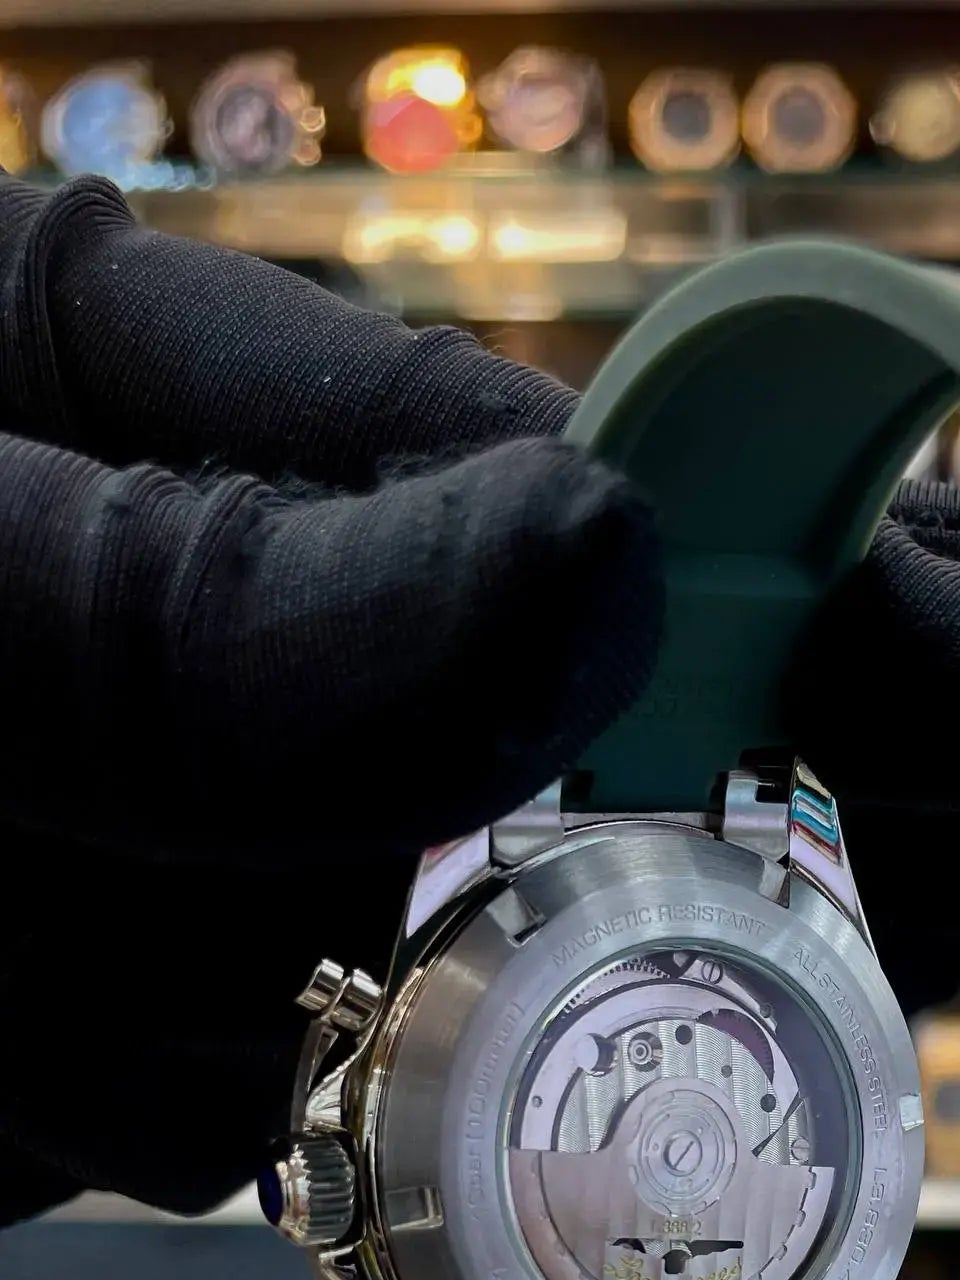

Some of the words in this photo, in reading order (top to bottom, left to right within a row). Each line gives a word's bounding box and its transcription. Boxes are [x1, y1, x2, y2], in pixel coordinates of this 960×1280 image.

[551, 906, 653, 968] MAGNETIC
[658, 904, 766, 937] RESISTANT
[792, 946, 818, 982] ALL
[818, 973, 877, 1077] STAINLESS
[868, 1076, 890, 1133] STEEL
